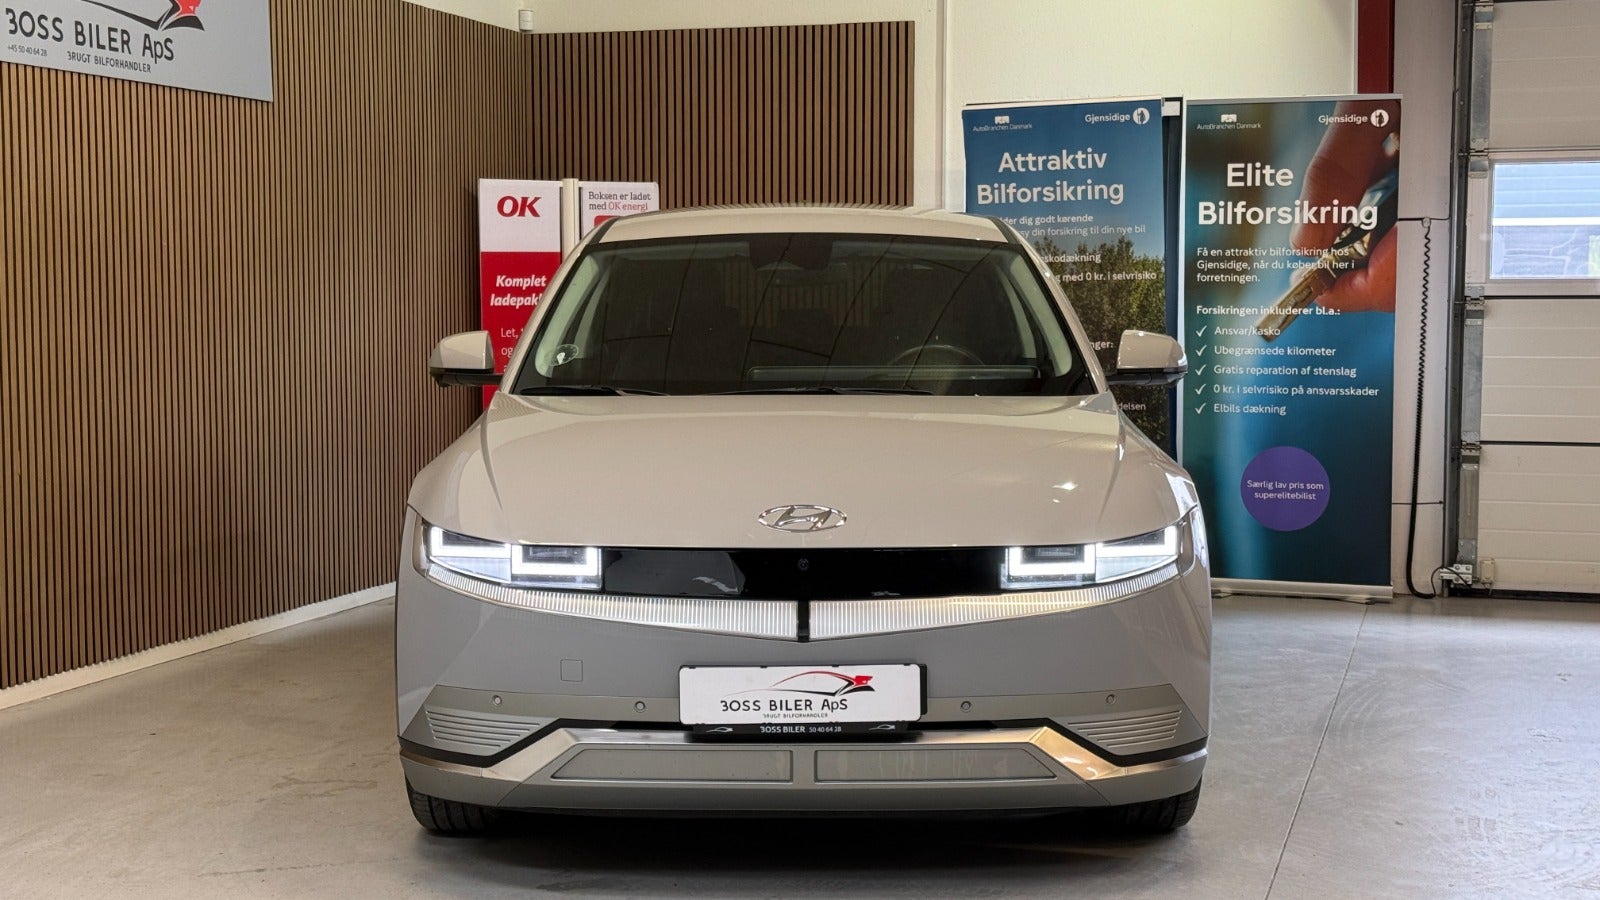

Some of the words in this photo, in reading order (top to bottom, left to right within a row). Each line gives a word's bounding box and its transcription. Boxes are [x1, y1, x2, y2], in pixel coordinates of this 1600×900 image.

[74, 20, 132, 55] BILER
[142, 33, 174, 64] ApS
[94, 55, 152, 73] BILFORHANDLER
[1084, 113, 1131, 124] Gjensidige
[1318, 114, 1368, 125] Gjensidige
[998, 147, 1108, 173] Attraktiv
[1227, 162, 1294, 187] Elite
[588, 191, 618, 200] Boksen
[630, 192, 652, 201] ladet
[977, 179, 1124, 205] Bilforsikring
[497, 195, 541, 218] OK
[588, 202, 607, 210] med
[608, 202, 621, 210] OK
[622, 203, 648, 213] energi
[1019, 215, 1034, 226] dig
[1035, 215, 1056, 226] godt
[1057, 214, 1094, 224] kørende
[1198, 199, 1379, 230] Bilforsikring
[1031, 227, 1046, 237] din
[1047, 226, 1089, 237] forsikring
[1089, 225, 1100, 234] til
[1101, 225, 1115, 234] din
[1116, 227, 1133, 236] nye
[1134, 224, 1146, 233] bil
[1196, 247, 1209, 257] Få
[1210, 249, 1223, 257] en
[1224, 247, 1268, 257] attraktiv
[1269, 246, 1329, 258] bilforsikring
[1330, 247, 1350, 256] hos
[1196, 260, 1251, 272] Gjensidige,
[1253, 260, 1269, 269] når
[1271, 260, 1285, 269] du
[1286, 260, 1316, 269] køber
[1317, 260, 1330, 269] bil
[1332, 260, 1349, 269] her
[1351, 260, 1355, 269] i
[495, 274, 547, 290] Komplet
[1062, 272, 1084, 282] med
[1085, 272, 1092, 281] 0
[1093, 271, 1106, 281] kr.
[1112, 270, 1157, 281] selvrisiko
[1196, 273, 1260, 284] forretningen.
[1196, 305, 1258, 317] Forsikringen
[1260, 306, 1313, 316] inkluderer
[1315, 306, 1341, 316] bl.a.:
[501, 327, 519, 339] Let,
[1214, 325, 1281, 336] Ansvar/kasko
[1214, 346, 1285, 357] Ubegrænsede
[1286, 346, 1337, 356] kilometer
[1213, 365, 1244, 374] Gratis
[1246, 366, 1299, 376] reparation
[1301, 366, 1311, 375] af
[1313, 367, 1357, 378] stenslag
[1213, 384, 1221, 394] 0
[1222, 384, 1235, 394] kr.
[1242, 385, 1289, 395] selvrisiko
[1291, 385, 1305, 396] på
[1306, 386, 1380, 396] ansvarsskader
[1213, 403, 1241, 413] Elbils
[1242, 404, 1287, 416] dækning
[1247, 480, 1274, 490] Særlig
[1275, 481, 1287, 489] lav
[1288, 482, 1305, 490] pris
[1254, 491, 1317, 501] superelitebilist
[769, 699, 813, 712] BILER
[821, 699, 848, 713] ApS
[782, 725, 806, 733] BILER
